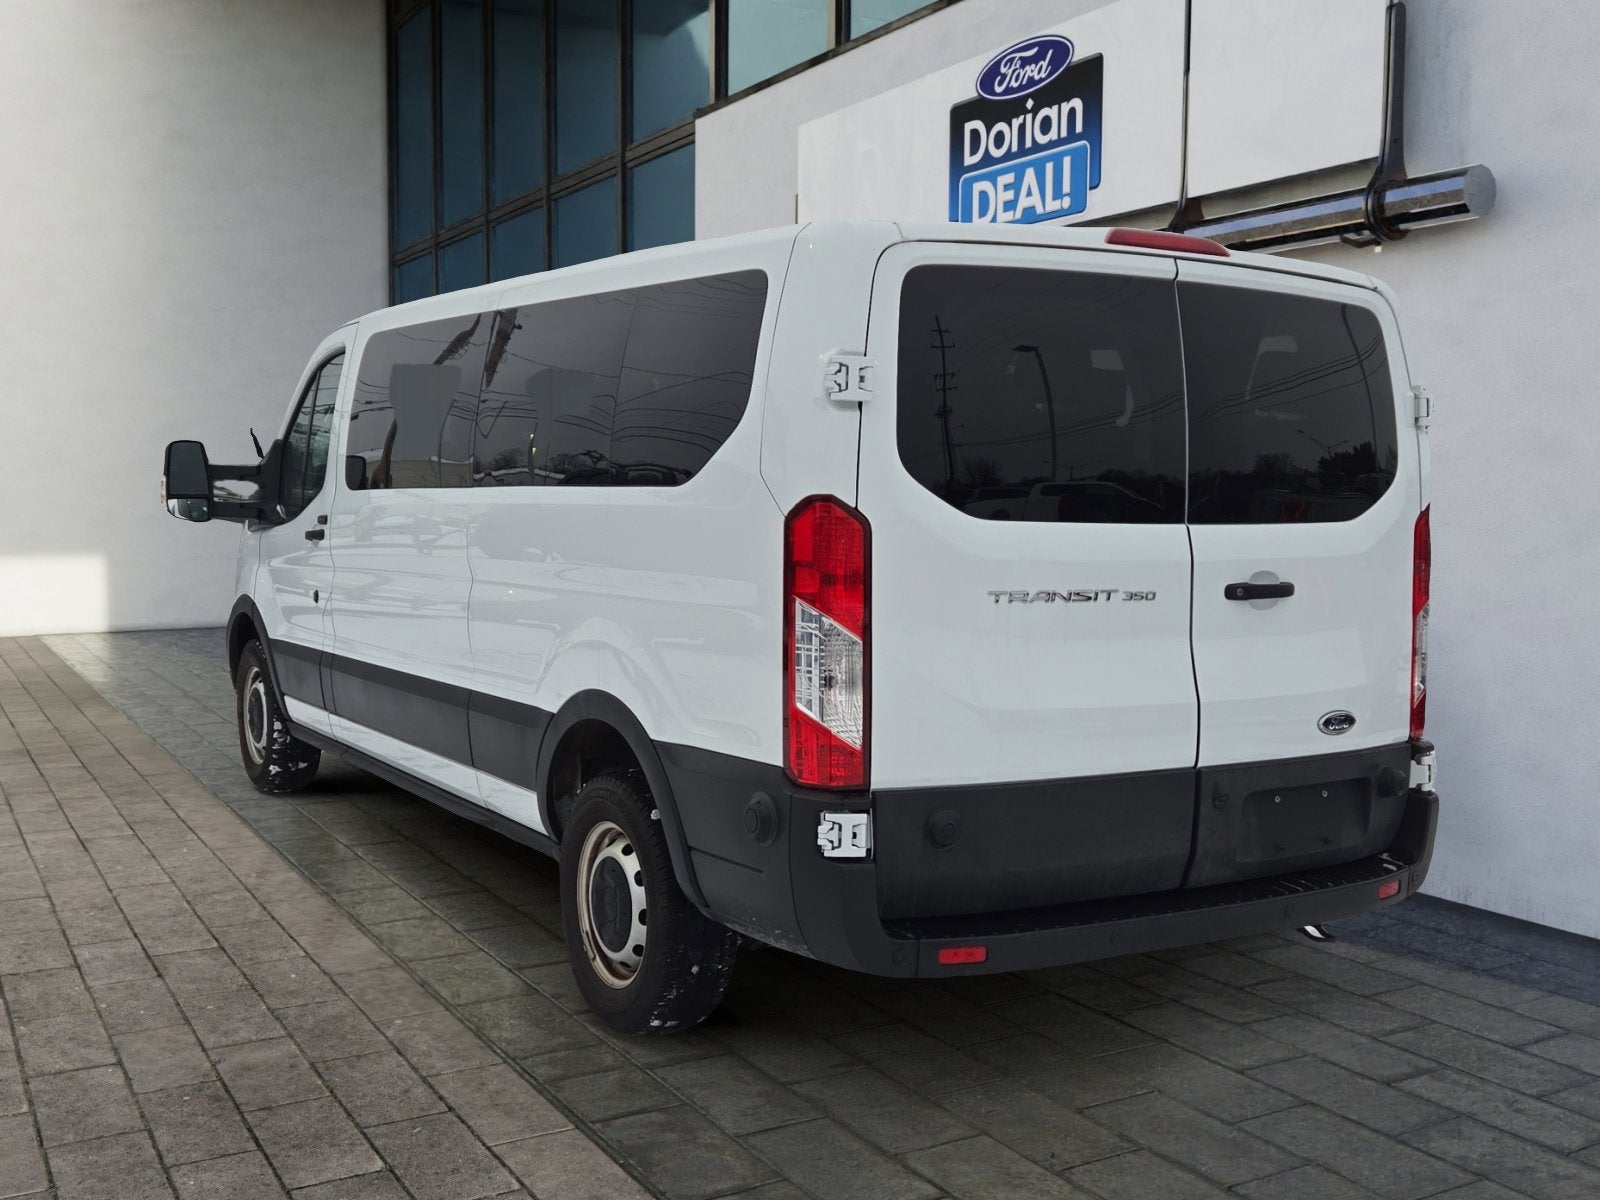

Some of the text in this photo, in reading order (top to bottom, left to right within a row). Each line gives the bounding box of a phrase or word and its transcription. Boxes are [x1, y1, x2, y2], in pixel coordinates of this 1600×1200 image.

[994, 46, 1054, 94] Ford
[963, 97, 1083, 167] Dorian
[972, 155, 1072, 224] DEAL!
[987, 589, 1157, 604] TRANSIT 350
